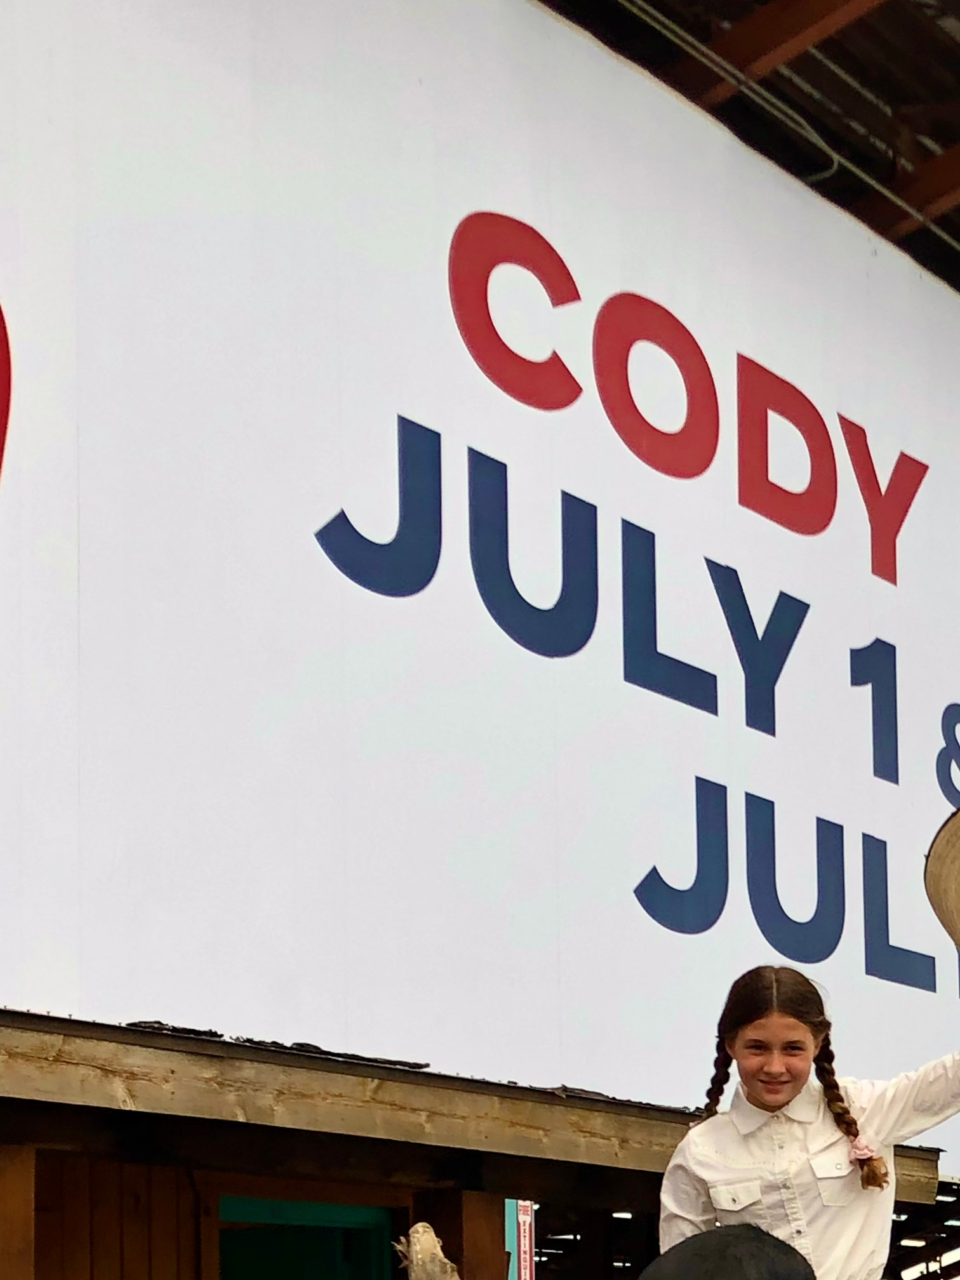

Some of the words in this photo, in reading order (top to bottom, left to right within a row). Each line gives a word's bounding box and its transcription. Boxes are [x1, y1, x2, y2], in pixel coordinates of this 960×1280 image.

[449, 211, 929, 587] CODY
[314, 413, 811, 738] JULY
[850, 637, 899, 785] 1
